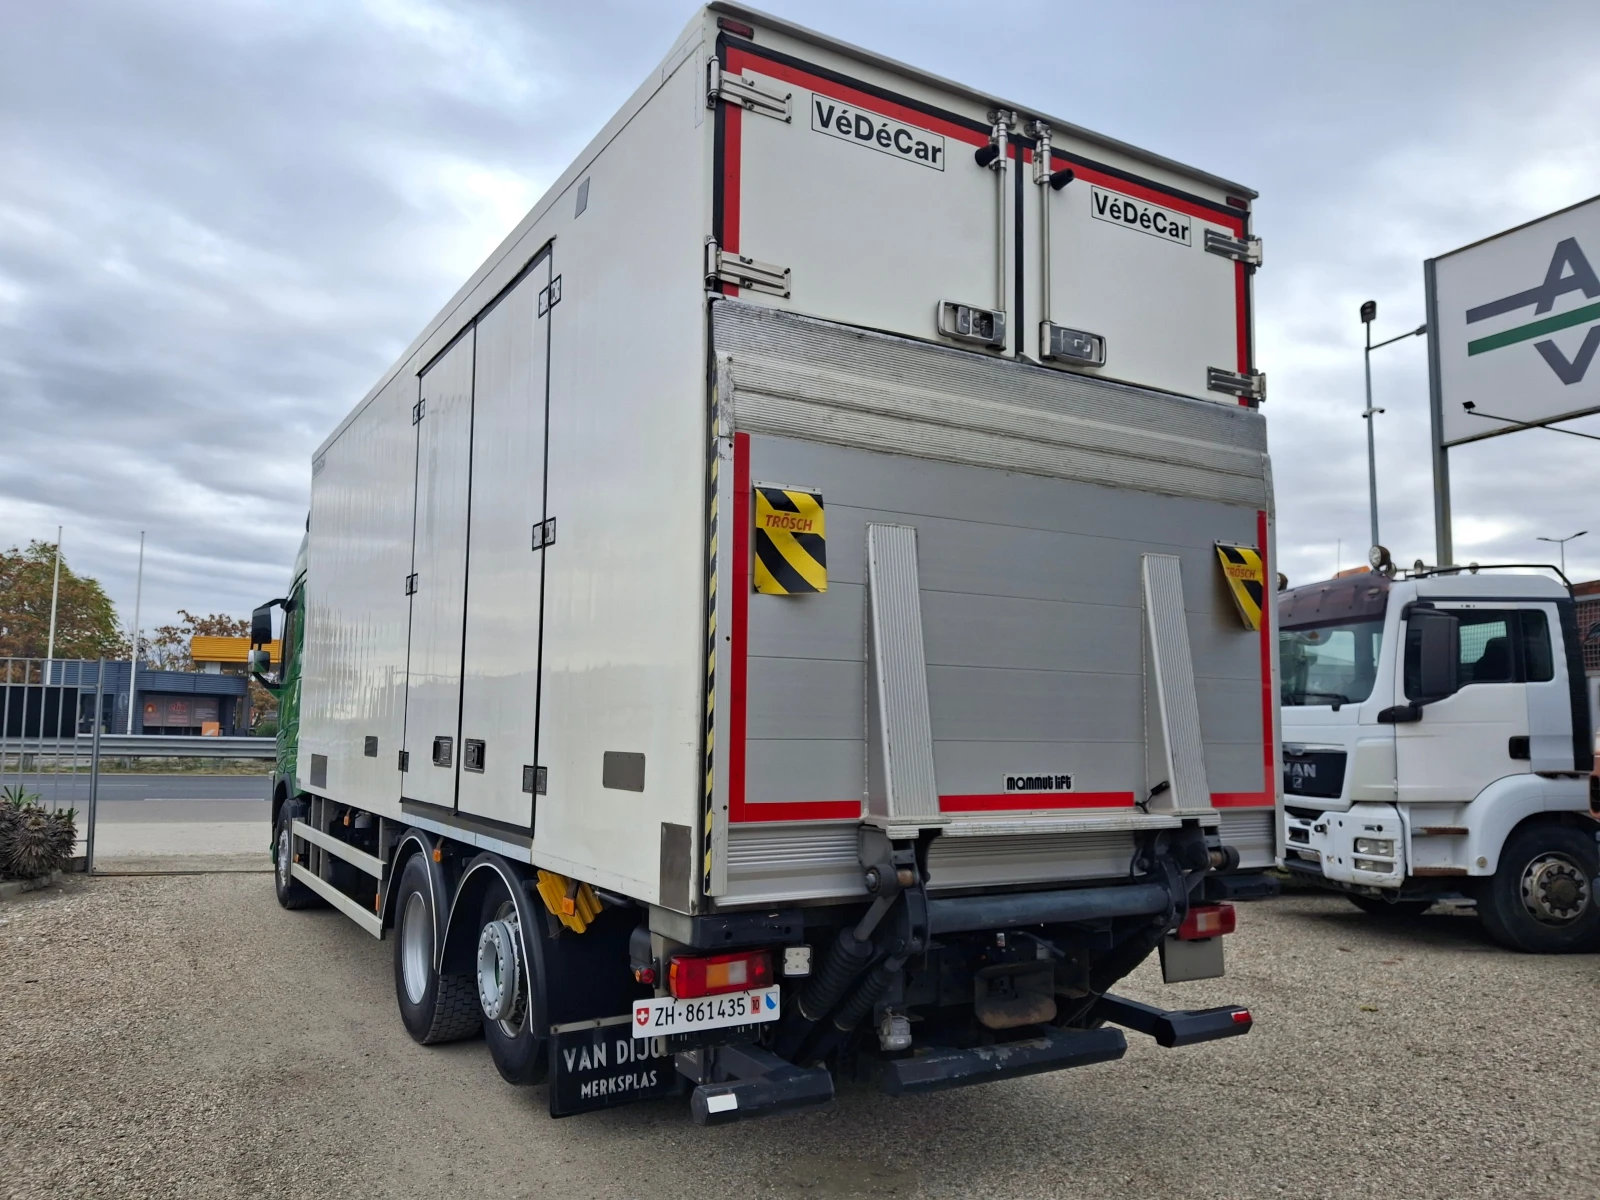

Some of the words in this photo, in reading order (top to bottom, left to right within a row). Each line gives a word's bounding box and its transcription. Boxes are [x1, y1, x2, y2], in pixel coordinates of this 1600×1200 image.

[815, 100, 942, 164] VéDéCar
[1093, 191, 1189, 241] VéDéCar
[765, 513, 813, 532] TRÖSCH
[1007, 775, 1054, 791] mammut
[1054, 774, 1072, 790] lift
[563, 1043, 607, 1074] VAN
[580, 1070, 658, 1100] MERKSPLAS
